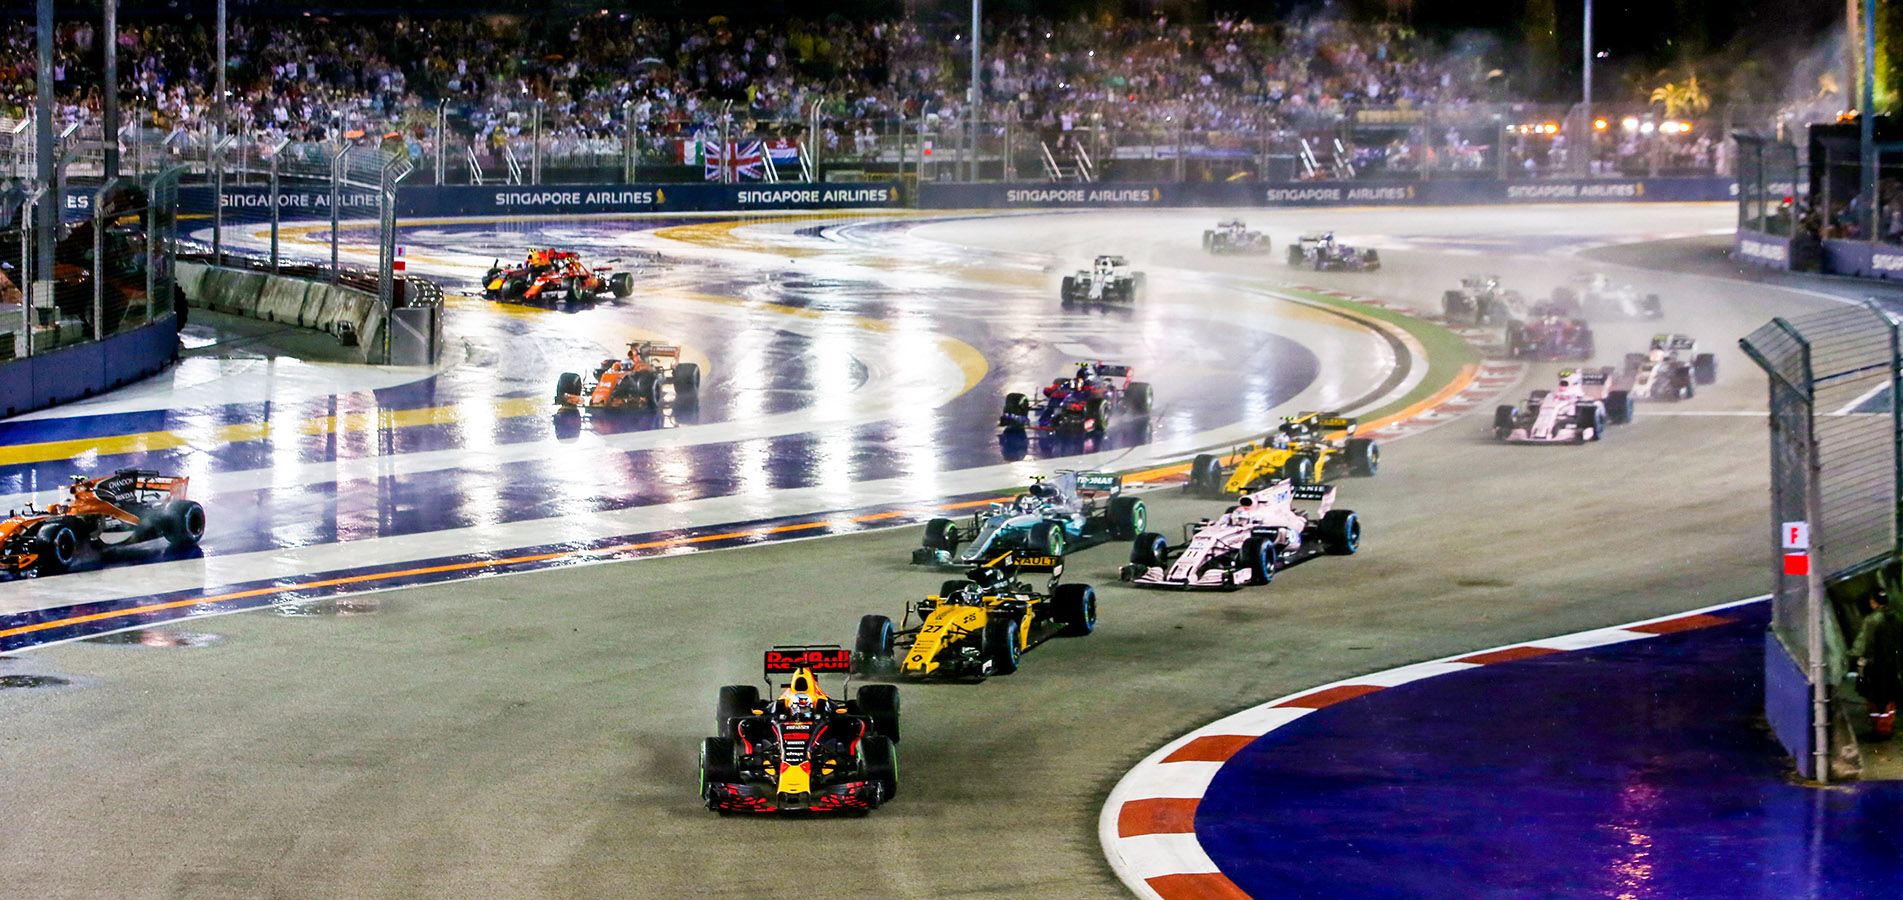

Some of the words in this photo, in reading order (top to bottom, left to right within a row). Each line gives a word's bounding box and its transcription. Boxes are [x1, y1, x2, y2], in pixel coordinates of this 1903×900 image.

[220, 194, 309, 207] SINGAORE
[496, 192, 580, 205] SINGAPORE
[586, 192, 652, 204] AIRLINES
[738, 190, 819, 203] SINGAPORE
[823, 189, 887, 202] AIRLINES
[1007, 190, 1085, 201] SINGAPORE
[1088, 189, 1150, 201] AIRLINES
[1267, 189, 1341, 201] SINGAPORE
[1347, 188, 1405, 200] AIRLINES
[66, 195, 88, 208] ES
[1791, 527, 1799, 545] F
[1013, 556, 1056, 566] NAULT
[923, 624, 943, 633] 27
